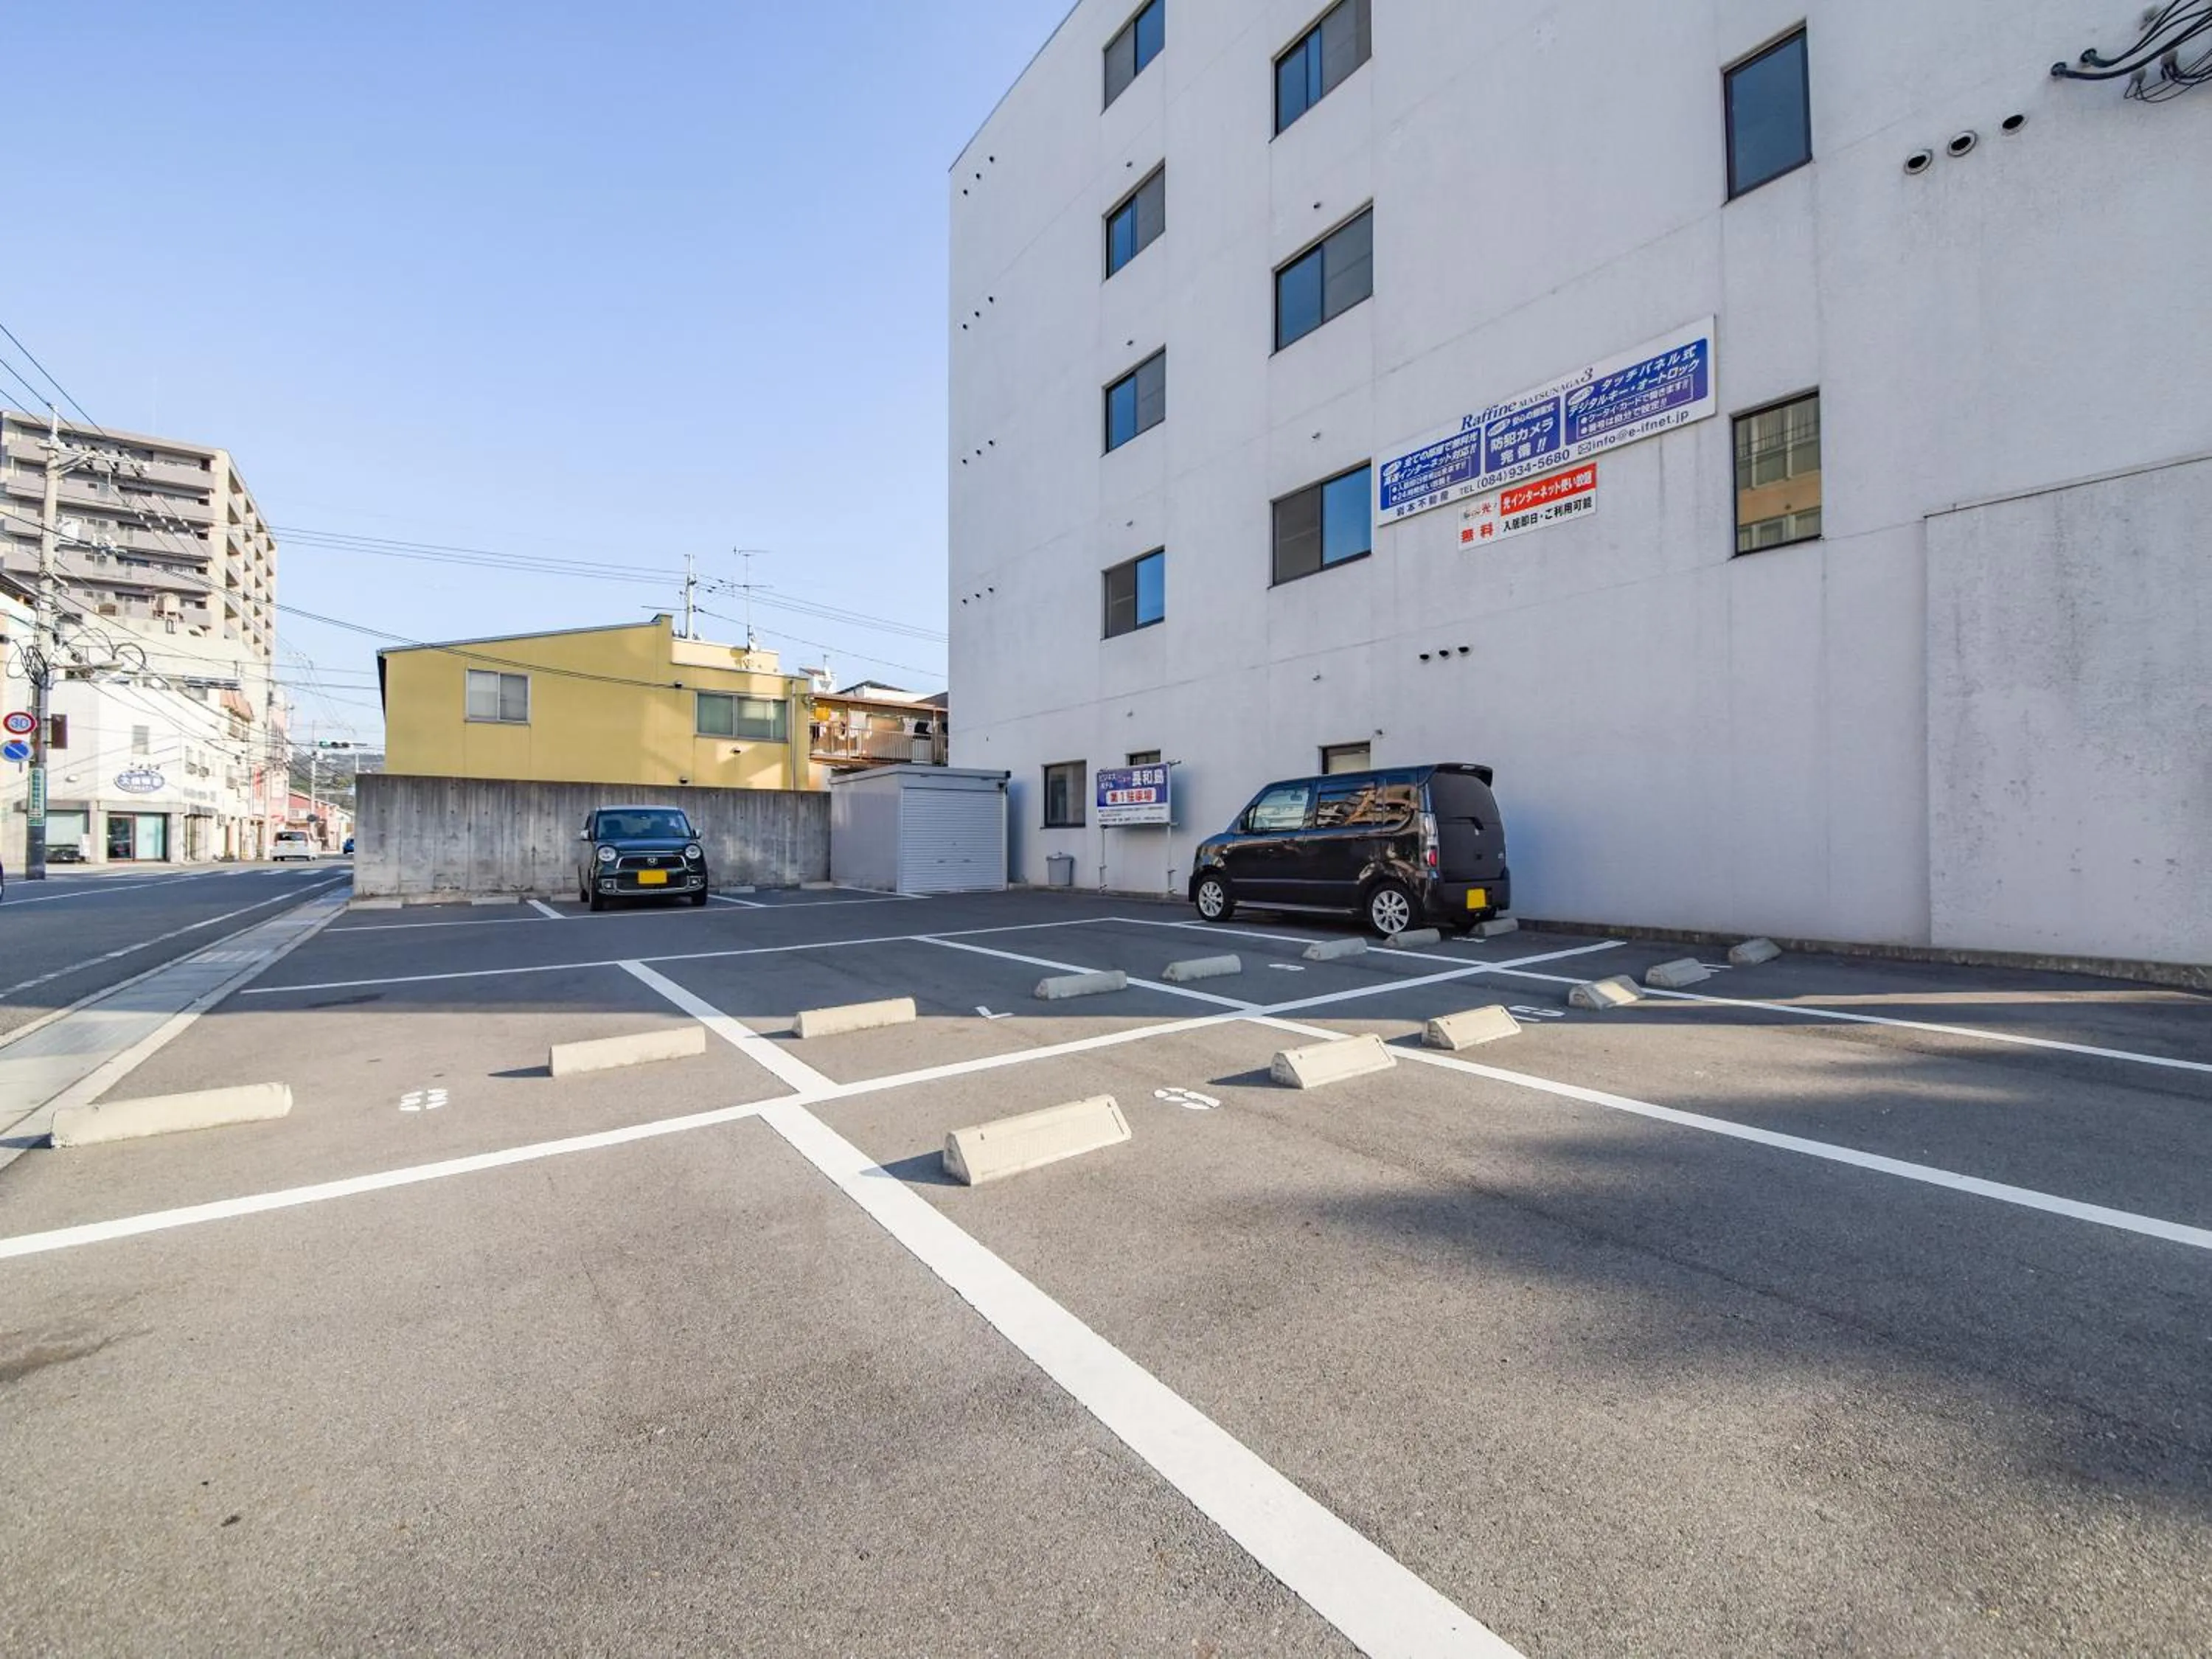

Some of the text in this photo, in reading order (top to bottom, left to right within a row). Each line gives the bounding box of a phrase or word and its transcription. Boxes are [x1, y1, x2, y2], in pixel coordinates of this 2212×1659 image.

[1519, 378, 1580, 408] MATSUNAGA
[1580, 366, 1593, 383] 3
[1601, 344, 1697, 392] タッチパネル式
[1489, 417, 1554, 453] 防犯カメラ
[1593, 409, 1689, 450] info@e-ifnet.jp
[1460, 450, 1570, 495] TEL (084)934-5680
[1461, 522, 1493, 543] 無料
[10, 717, 29, 729] 30
